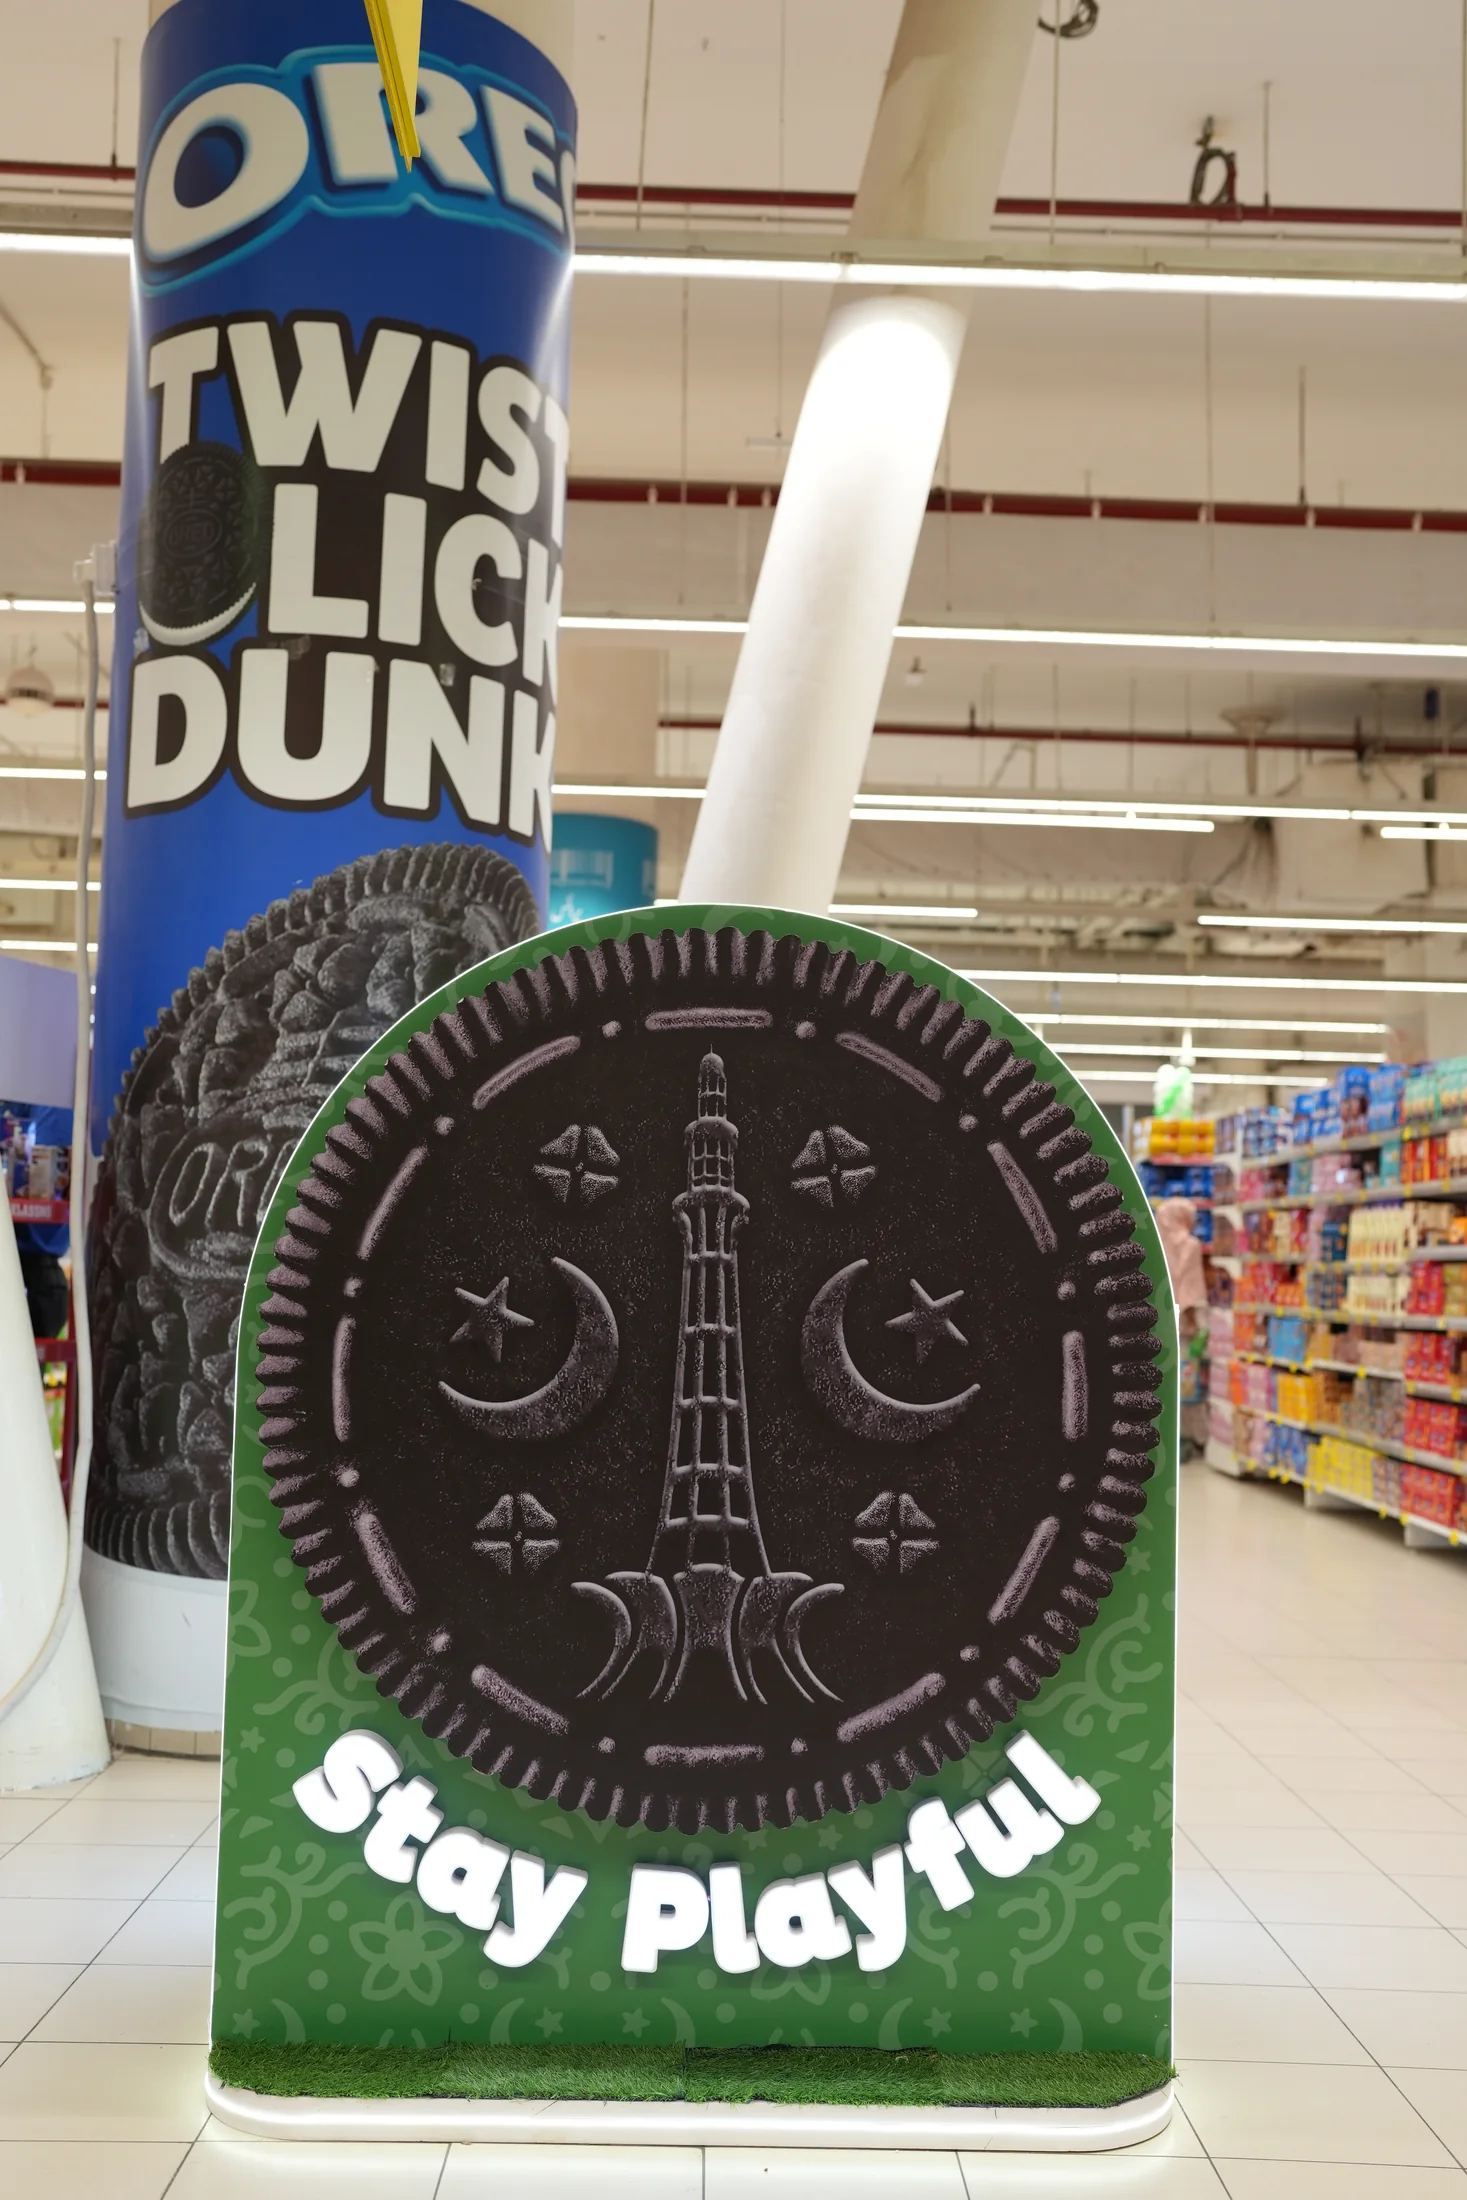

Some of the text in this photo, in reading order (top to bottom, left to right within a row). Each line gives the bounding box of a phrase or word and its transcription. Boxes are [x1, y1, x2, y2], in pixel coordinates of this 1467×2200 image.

[268, 484, 563, 706] LICK
[128, 649, 556, 854] DUNK
[292, 1729, 1101, 1974] Stay Playful
